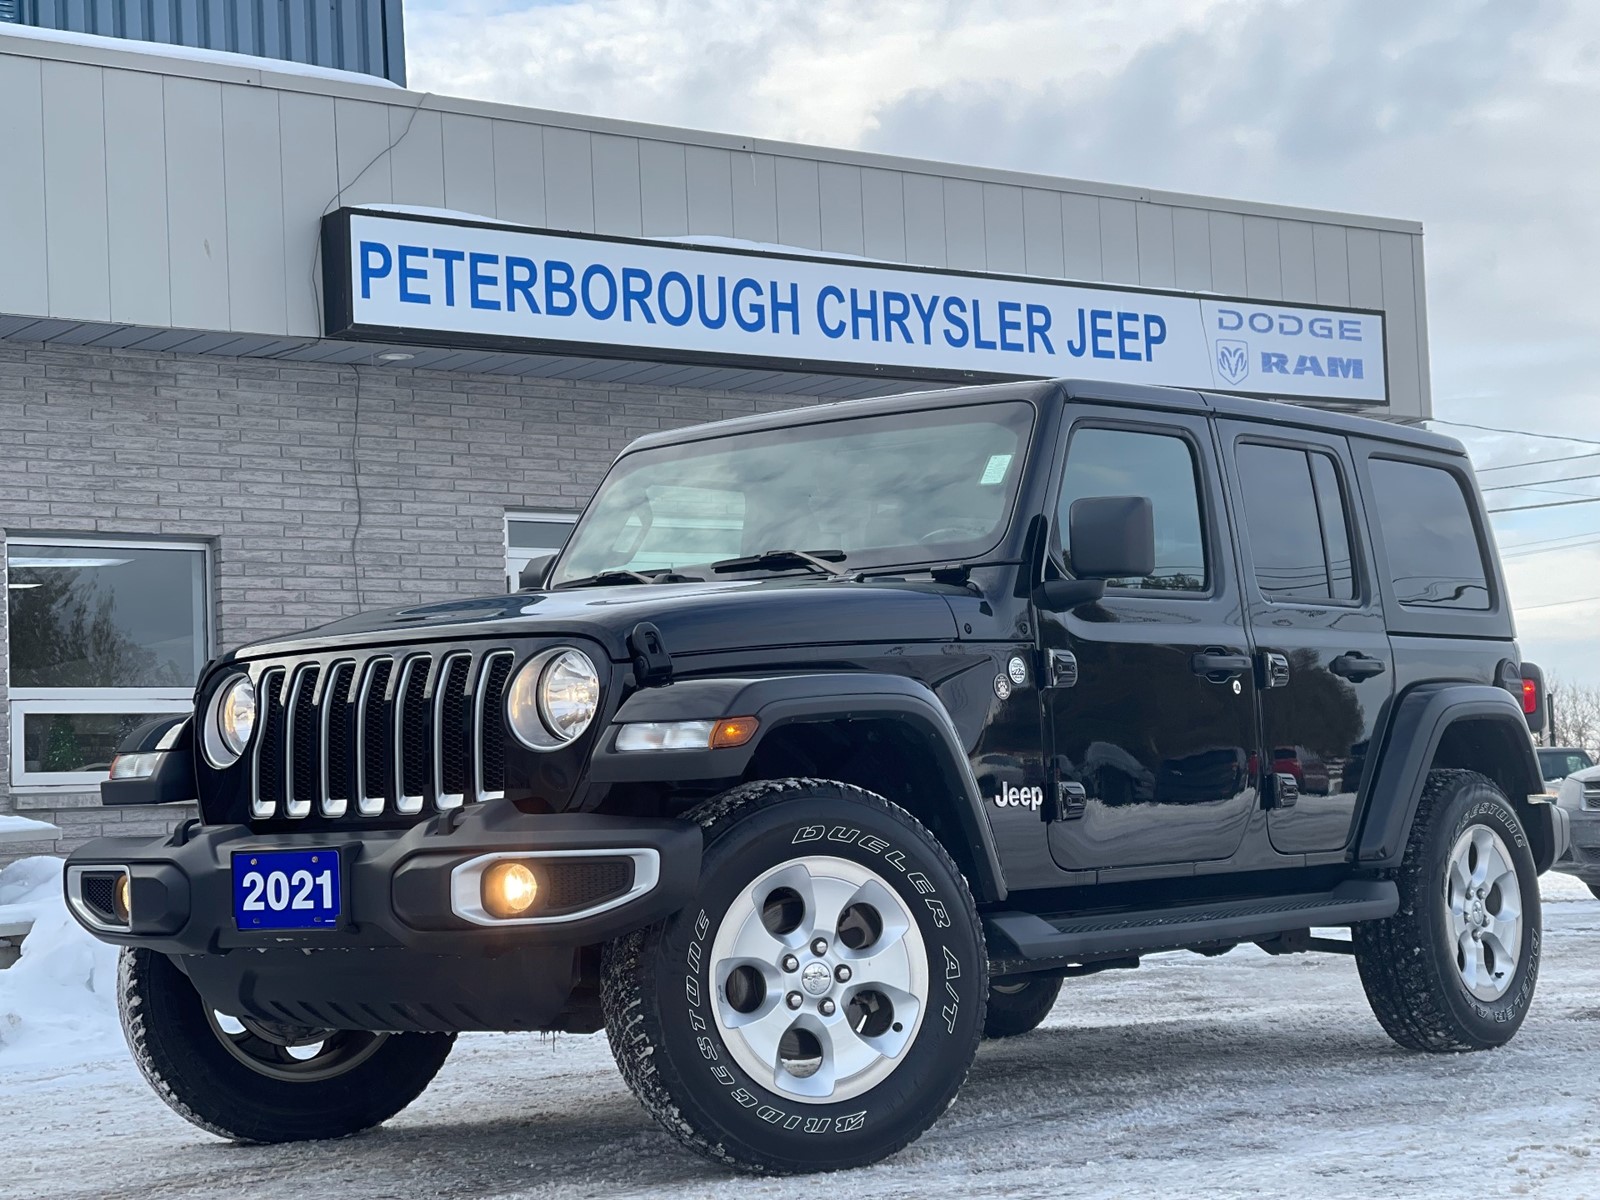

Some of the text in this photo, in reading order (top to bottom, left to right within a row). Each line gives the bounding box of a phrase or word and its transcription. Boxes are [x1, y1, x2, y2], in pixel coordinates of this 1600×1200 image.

[360, 241, 1167, 362] PETERBOROUGH CHRYSLER JEEP
[1218, 309, 1363, 341] DODGE
[1260, 351, 1364, 379] RAM
[995, 781, 1043, 811] Jeep
[242, 869, 333, 911] 2021
[791, 824, 959, 1035] DUELER A/T
[686, 909, 867, 1133] BRIDGESTONE
